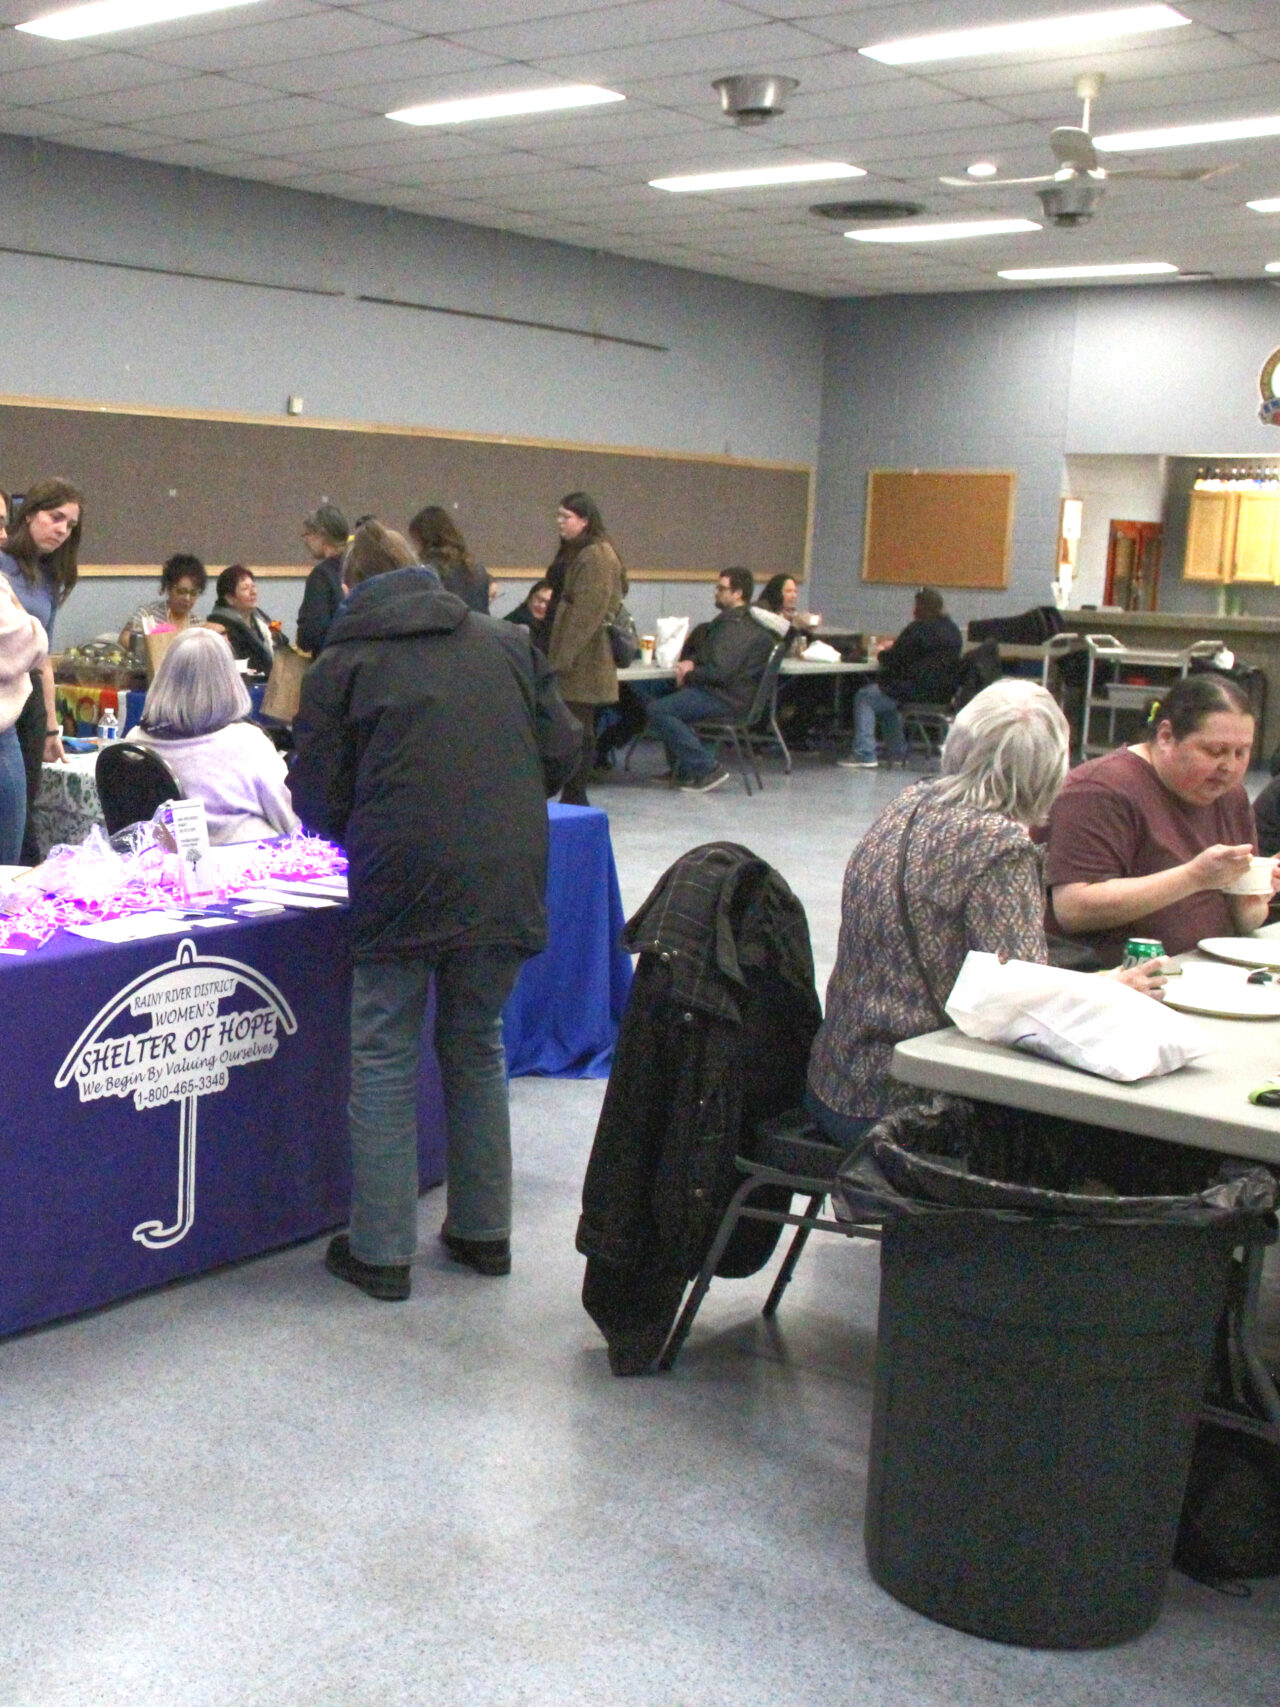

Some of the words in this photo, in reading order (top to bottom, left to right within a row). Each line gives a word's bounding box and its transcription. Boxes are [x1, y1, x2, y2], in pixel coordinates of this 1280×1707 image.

[134, 994, 164, 1010] RAINY
[164, 987, 192, 1004] RIVER
[194, 978, 235, 998] DISTRICT
[79, 1032, 177, 1077] SHELTER
[184, 1024, 214, 1053] OF
[219, 1011, 275, 1045] HOPE
[83, 1080, 103, 1097] We
[105, 1071, 146, 1093] Begin
[148, 1067, 163, 1083] By
[165, 1052, 217, 1077] Valuing
[219, 1043, 274, 1064] Ourselves
[137, 1073, 226, 1104] 1-800-465-3348
